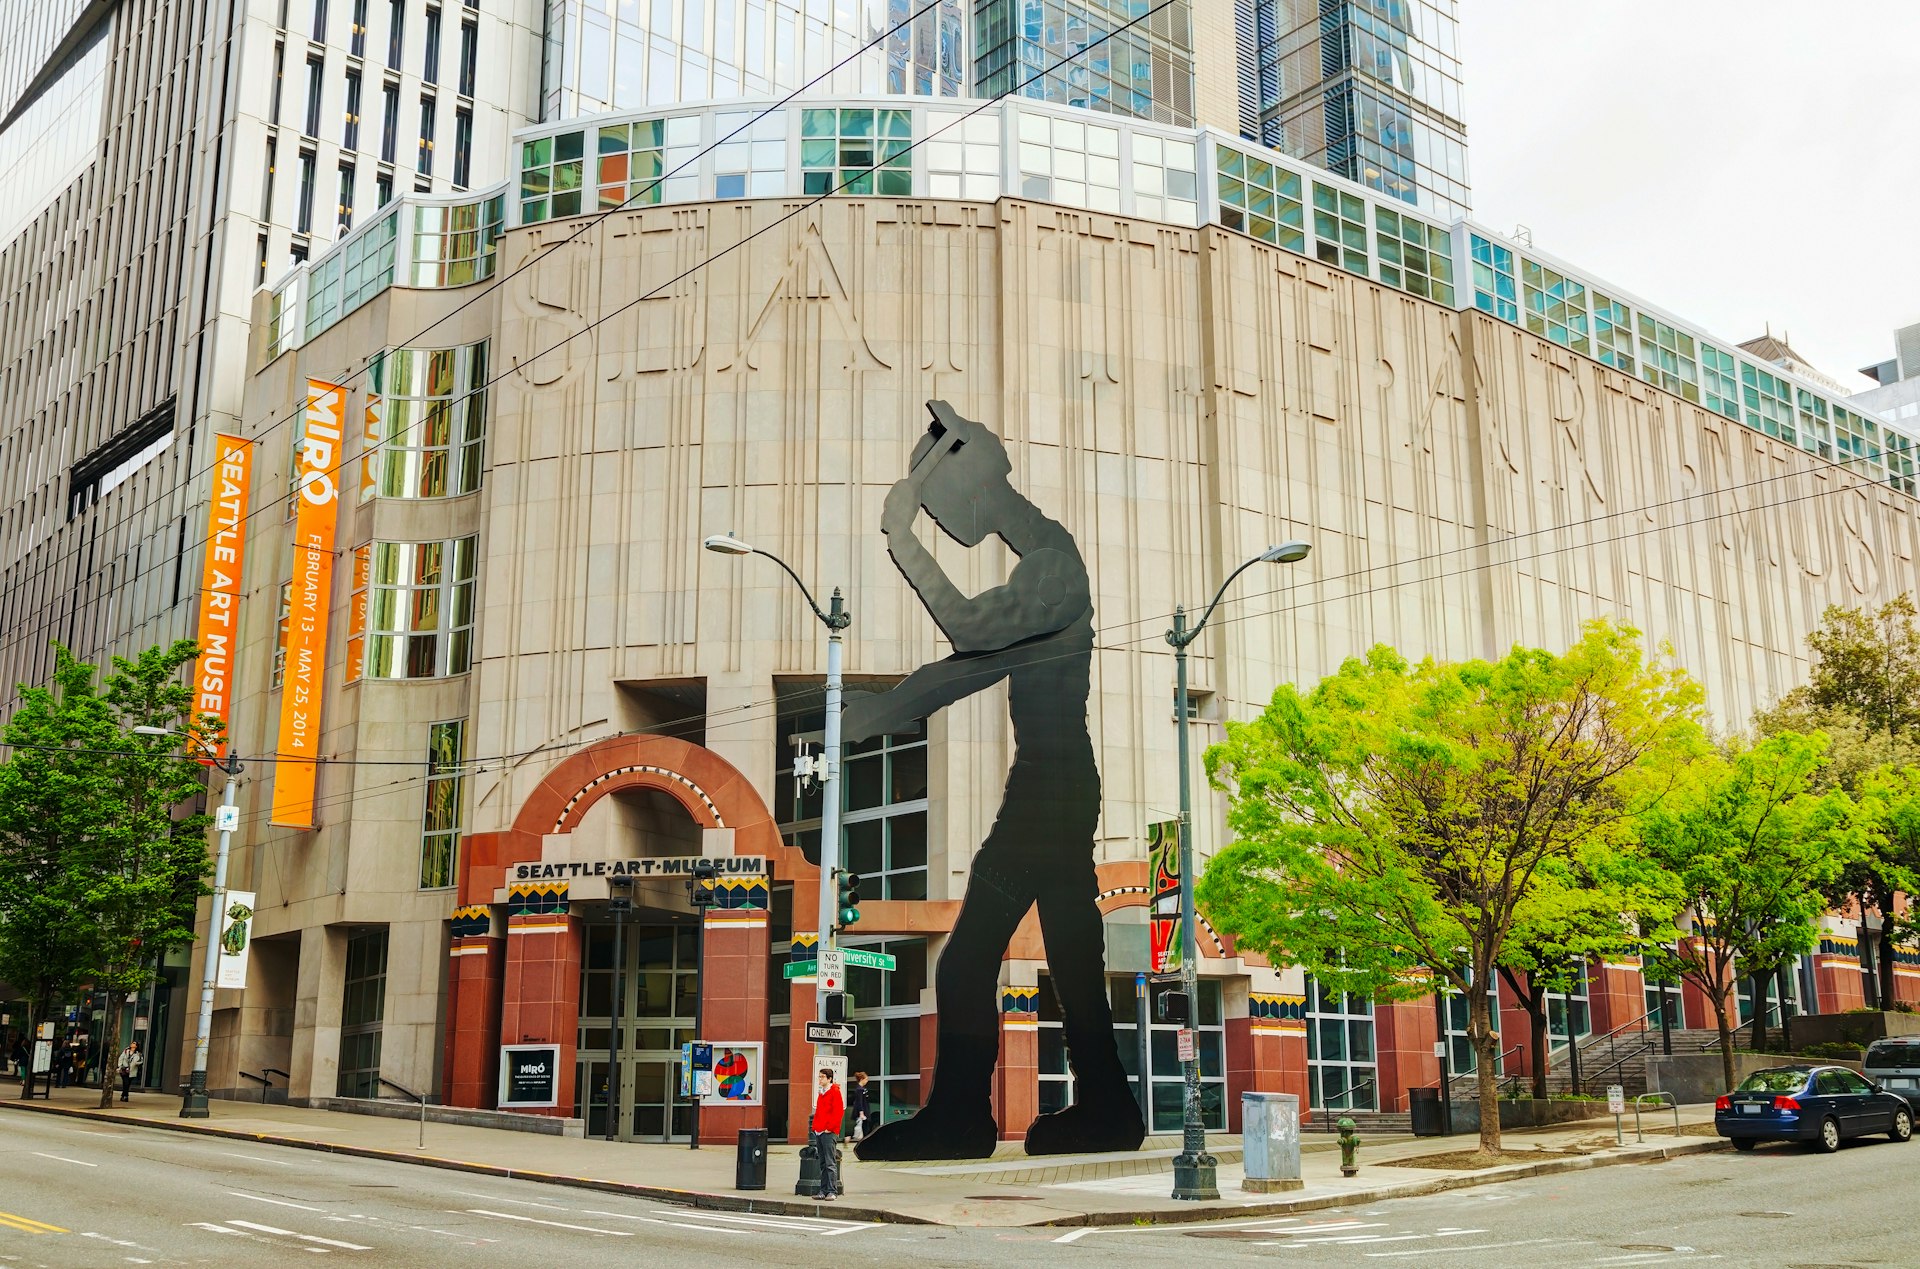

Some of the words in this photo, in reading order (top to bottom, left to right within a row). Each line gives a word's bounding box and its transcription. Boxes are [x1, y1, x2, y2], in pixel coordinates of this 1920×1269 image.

[301, 385, 341, 506] MIRÓ
[213, 446, 246, 564] SEATTLE
[303, 533, 322, 613] FEBRUARY
[209, 569, 233, 628] ART
[301, 615, 315, 633] 13
[297, 647, 313, 684] MAY
[294, 685, 309, 707] 25,
[291, 711, 307, 749] 2014
[517, 862, 606, 879] SEATTLE
[612, 860, 656, 876] ART
[662, 858, 761, 874] MUSEUM
[825, 953, 838, 962] NO
[840, 950, 877, 967] niversity
[878, 957, 885, 967] St
[1157, 950, 1176, 958] SEATTLE
[807, 964, 817, 973] Ave
[831, 971, 842, 979] RED
[811, 1028, 825, 1038] ONE
[826, 1028, 841, 1038] WAY
[520, 1062, 546, 1075] MIRÓ
